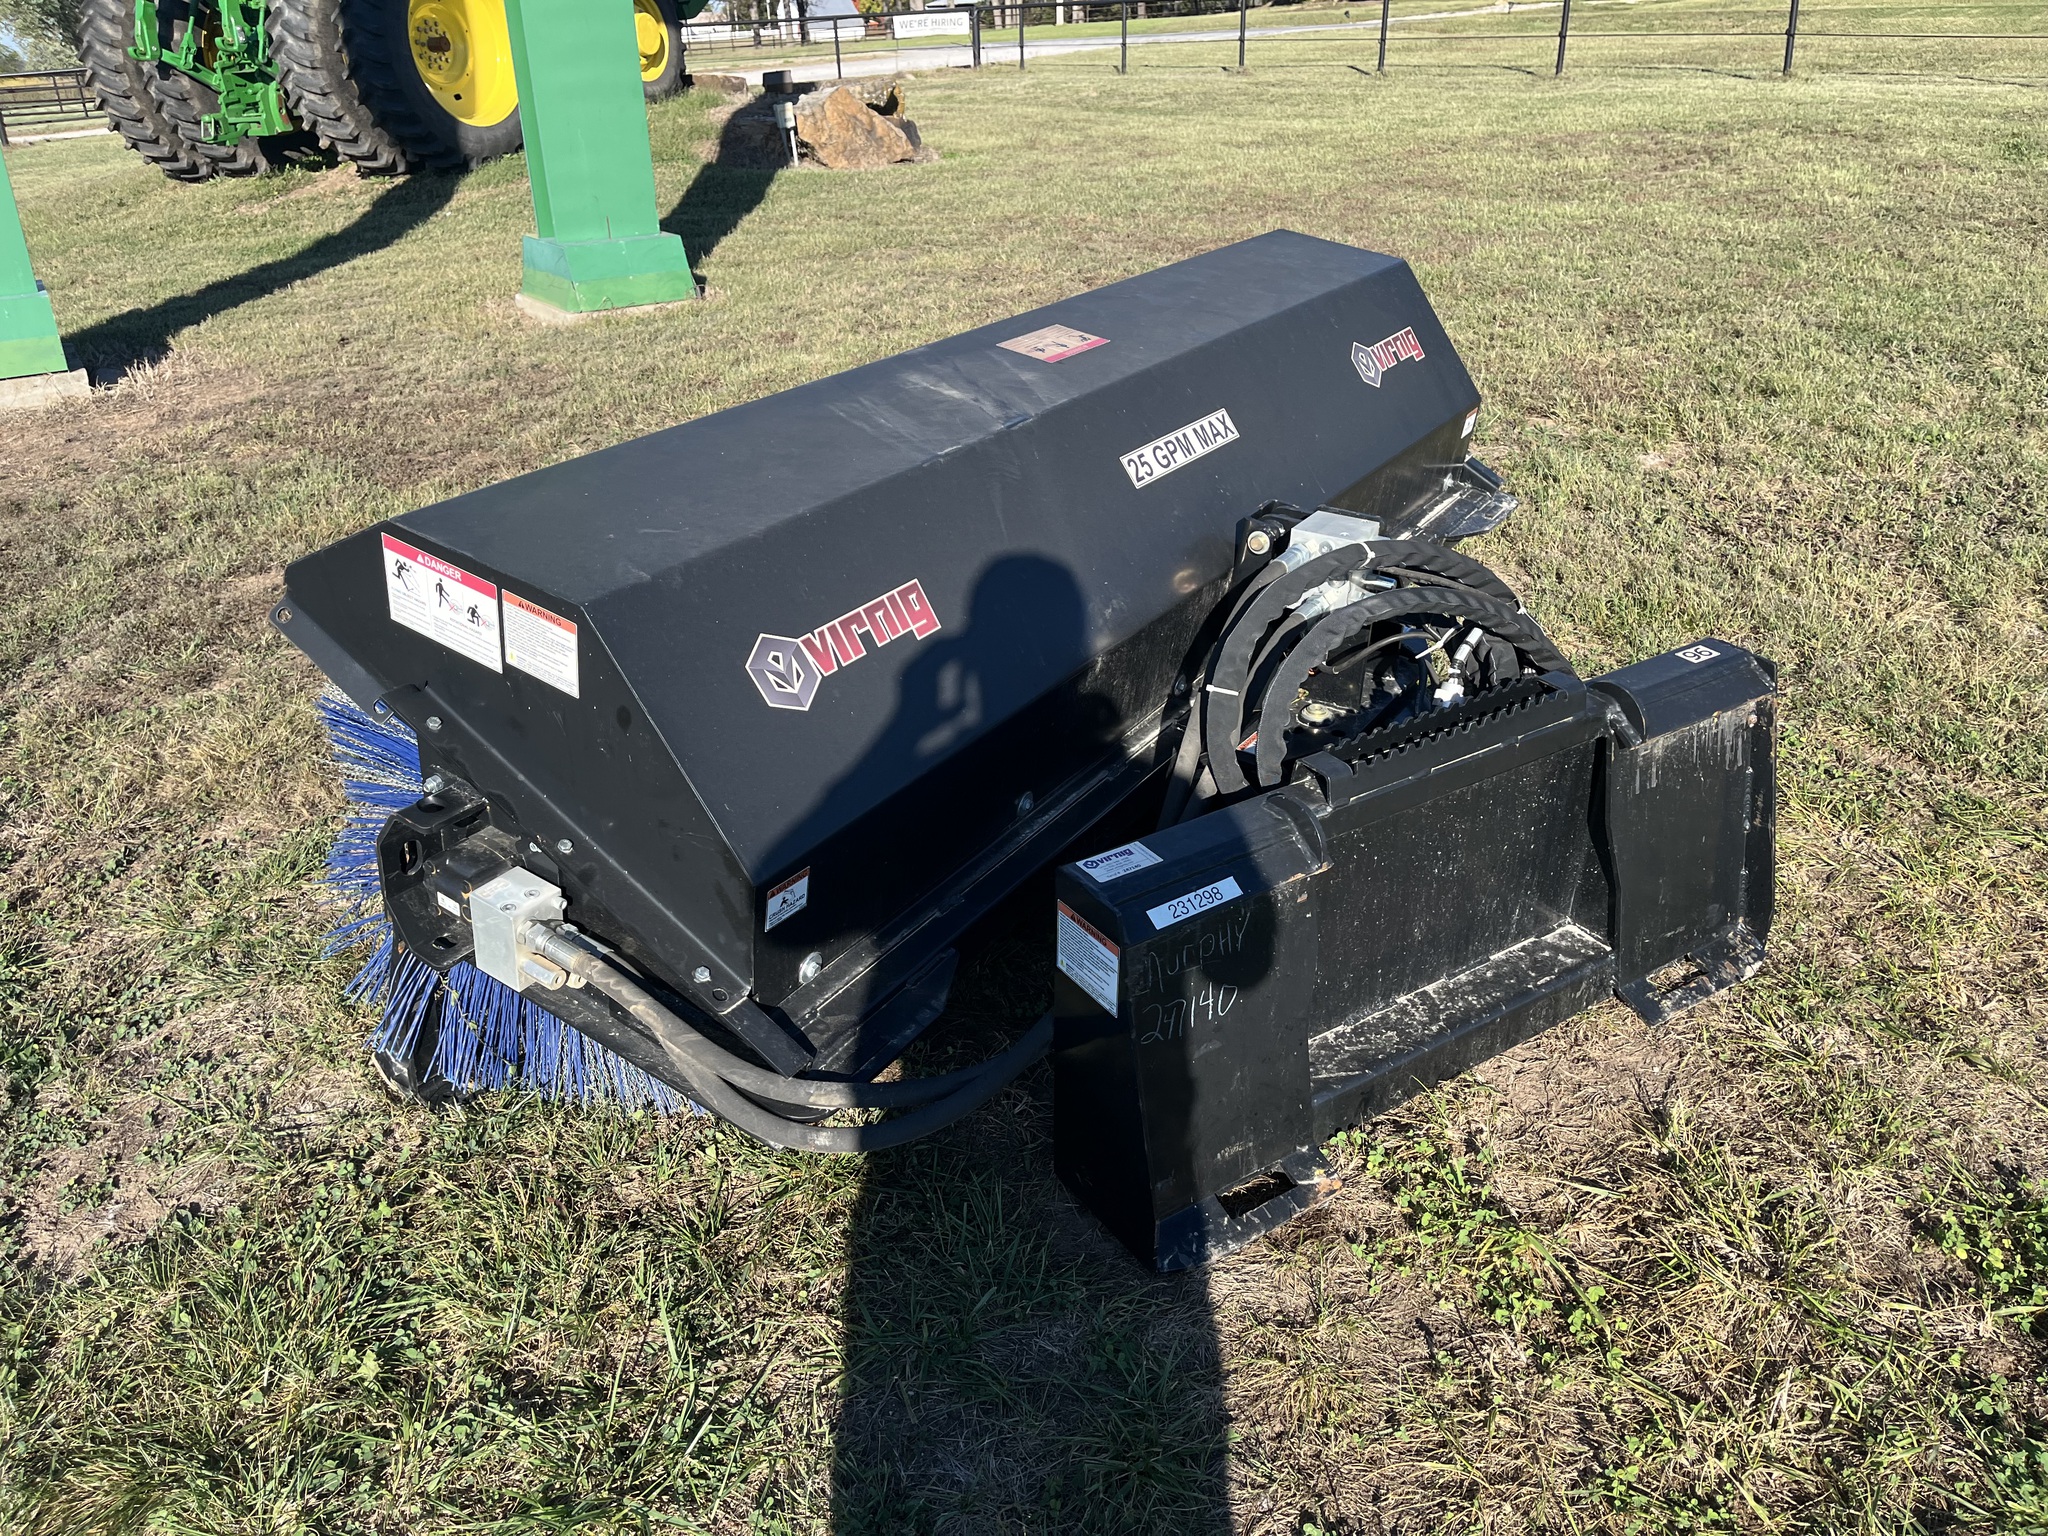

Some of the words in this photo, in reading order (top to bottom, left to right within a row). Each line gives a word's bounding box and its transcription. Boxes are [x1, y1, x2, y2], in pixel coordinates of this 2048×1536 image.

[899, 18, 928, 29] WE'RE
[930, 17, 963, 27] HIRING
[1127, 452, 1154, 483] 25
[1152, 432, 1197, 469] GPM
[1192, 413, 1236, 450] MAX
[423, 554, 462, 582] DANGER
[523, 603, 562, 627] WARNING
[1168, 886, 1224, 920] 231298
[1075, 914, 1108, 947] WARNING
